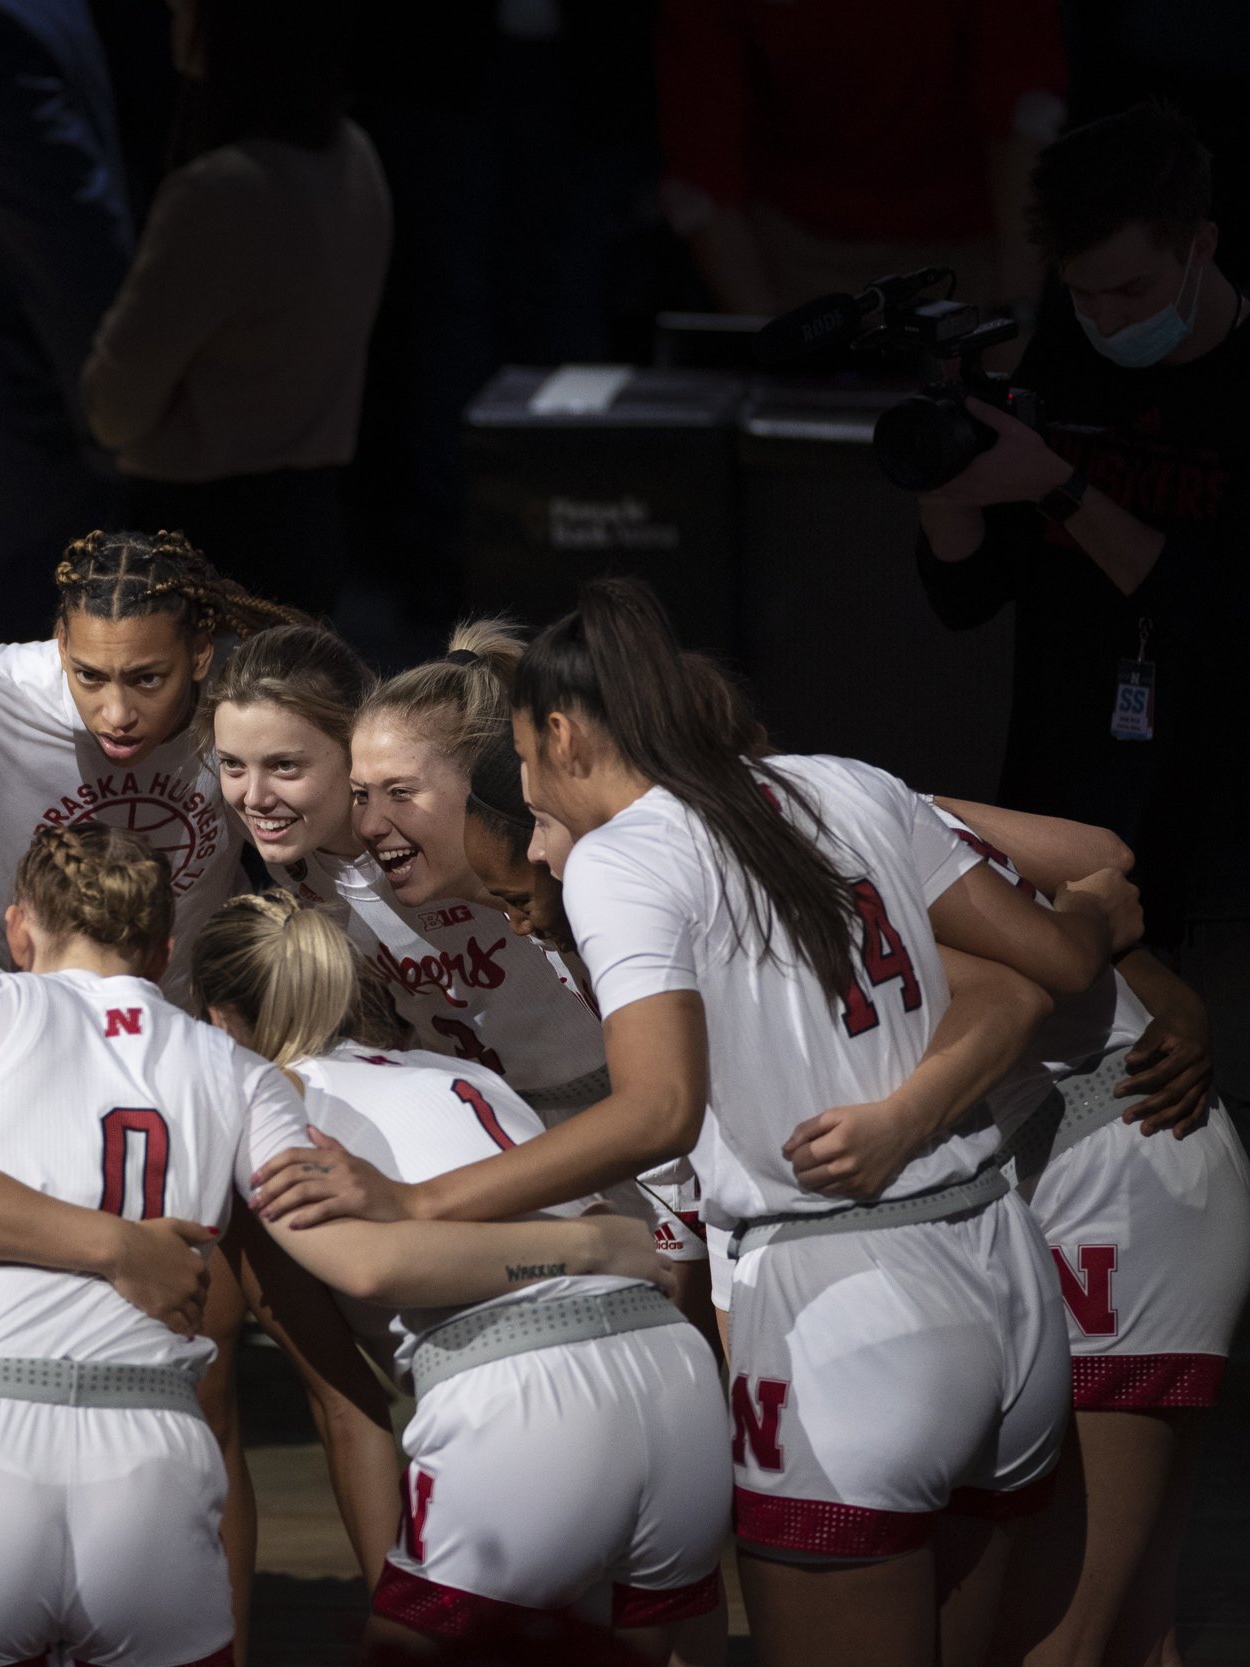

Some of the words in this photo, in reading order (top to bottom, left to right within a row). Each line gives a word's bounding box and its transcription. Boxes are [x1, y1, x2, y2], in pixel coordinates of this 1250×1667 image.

[1120, 687, 1145, 714] SS
[34, 772, 139, 838] RASKA
[150, 772, 219, 860] HUSKERS
[104, 1008, 143, 1038] N
[100, 1107, 170, 1220] 0
[1048, 1244, 1118, 1338] N
[731, 1372, 790, 1474] N
